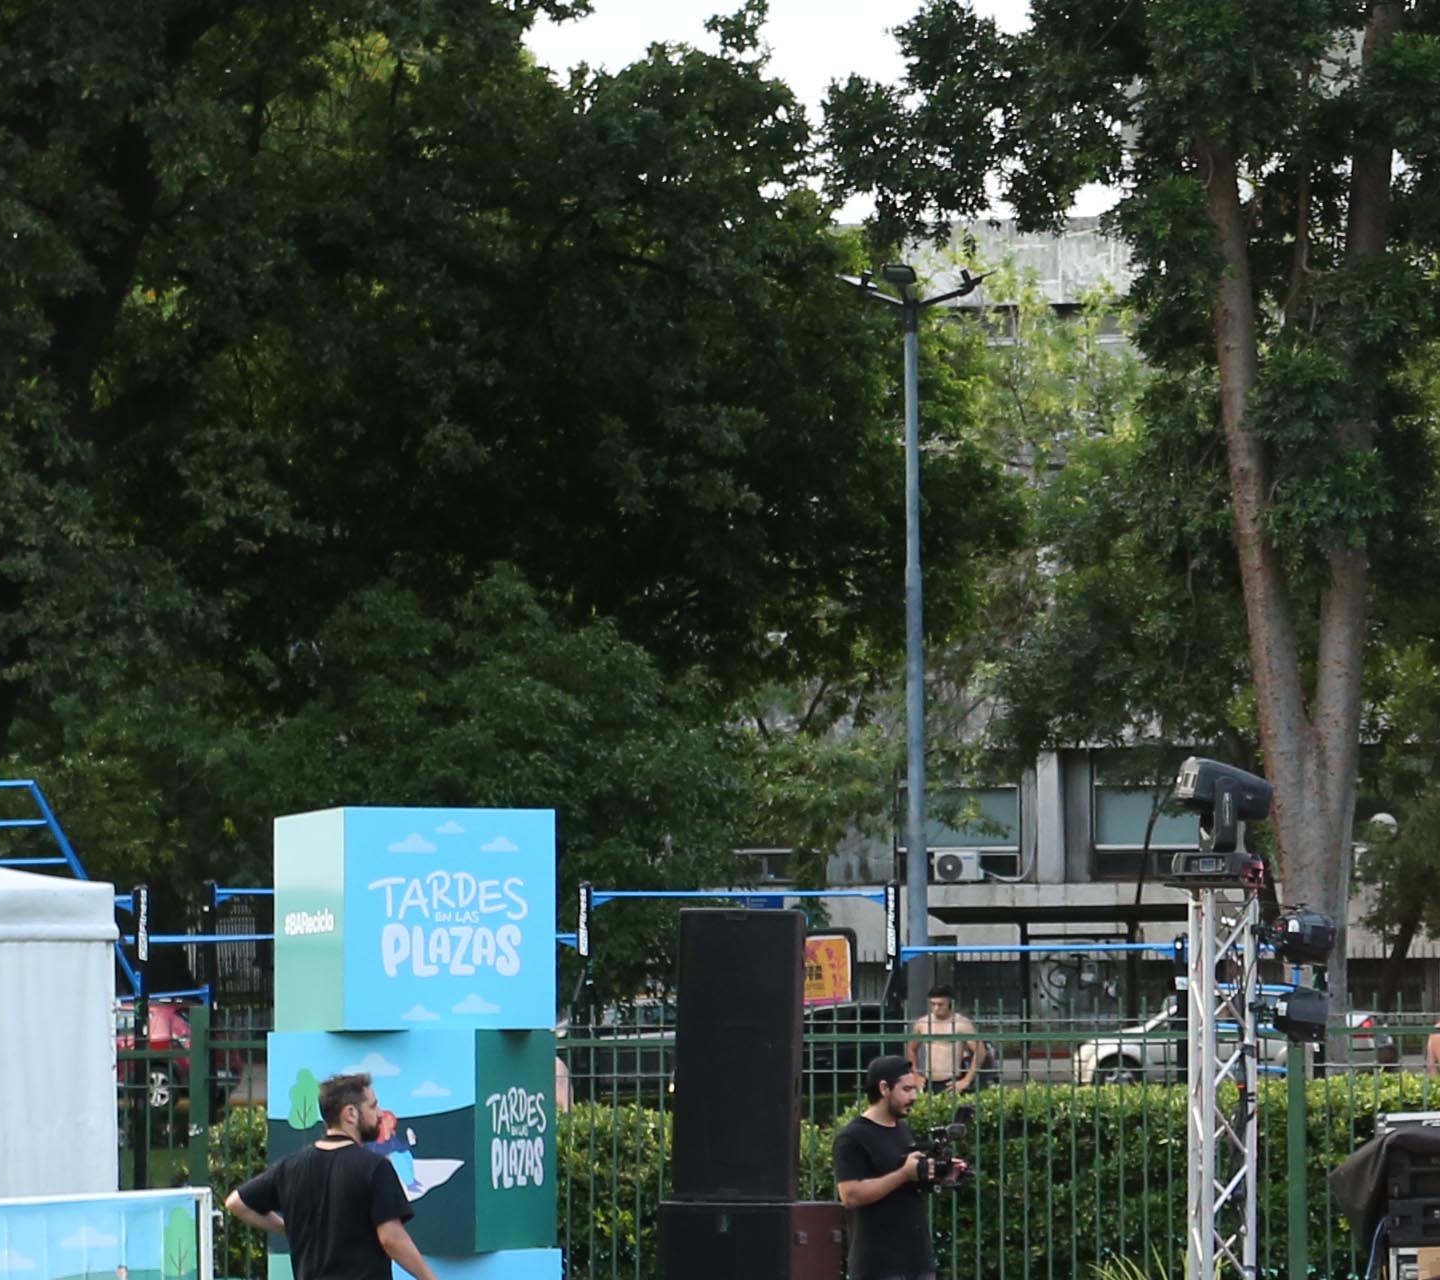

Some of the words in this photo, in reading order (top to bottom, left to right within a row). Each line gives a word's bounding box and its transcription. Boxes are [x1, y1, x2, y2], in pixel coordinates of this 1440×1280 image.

[368, 870, 528, 920] TARDES
[435, 911, 451, 923] EN
[455, 911, 480, 924] LAS
[381, 923, 522, 977] PLAZAS
[485, 1086, 547, 1135] TARDES
[491, 1136, 545, 1190] PLAZAS
